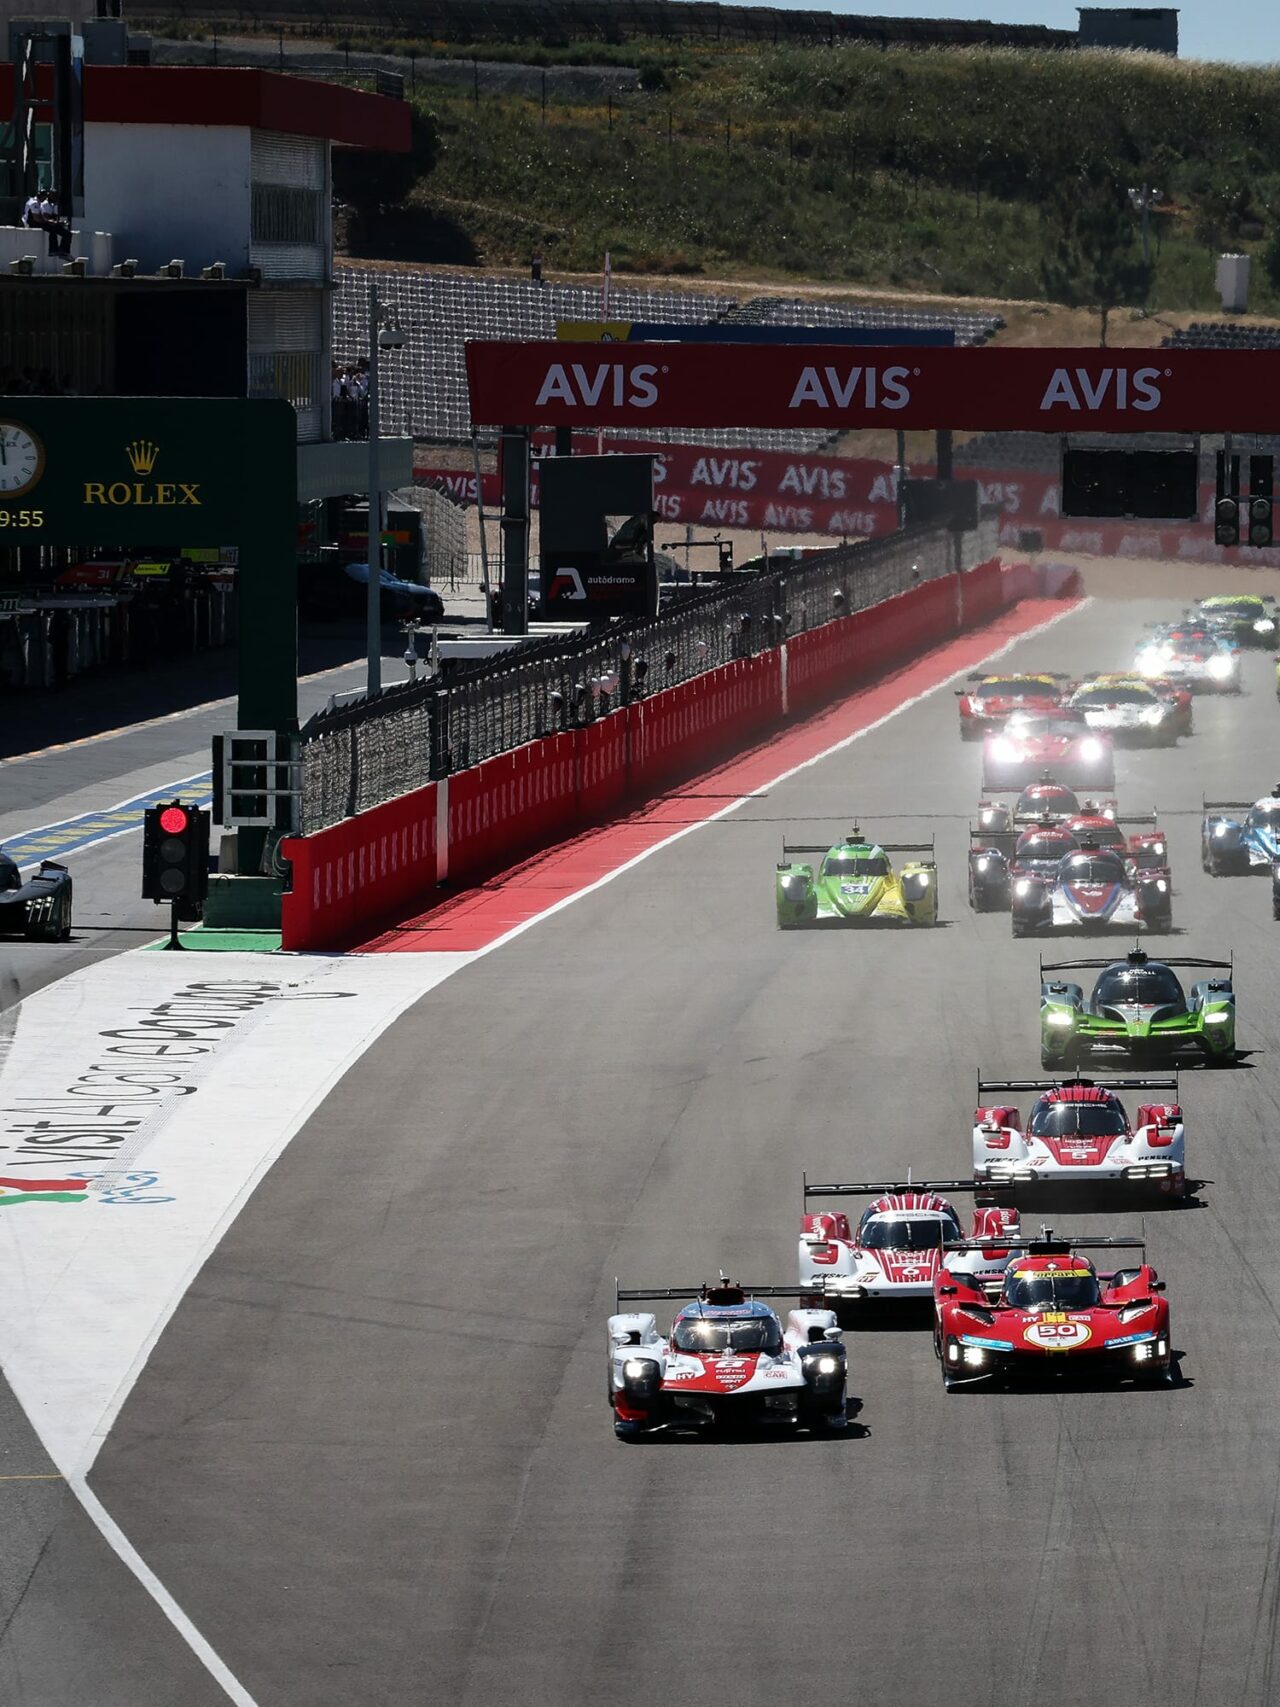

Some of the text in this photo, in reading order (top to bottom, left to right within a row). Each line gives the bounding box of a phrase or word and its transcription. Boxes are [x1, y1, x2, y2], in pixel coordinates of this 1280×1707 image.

[536, 364, 657, 408] AVIS
[789, 366, 909, 410] AVIS
[1040, 368, 1160, 411] AVIS
[691, 457, 757, 491] AVIS
[779, 465, 847, 499] AVIS
[83, 482, 202, 505] ROLEX
[654, 495, 682, 519] VIS
[701, 499, 750, 525] AVIS
[845, 886, 864, 894] 34
[901, 1266, 920, 1276] 6
[1039, 1325, 1076, 1336] 50
[1108, 1335, 1134, 1346] ADLER
[677, 1372, 694, 1380] HY
